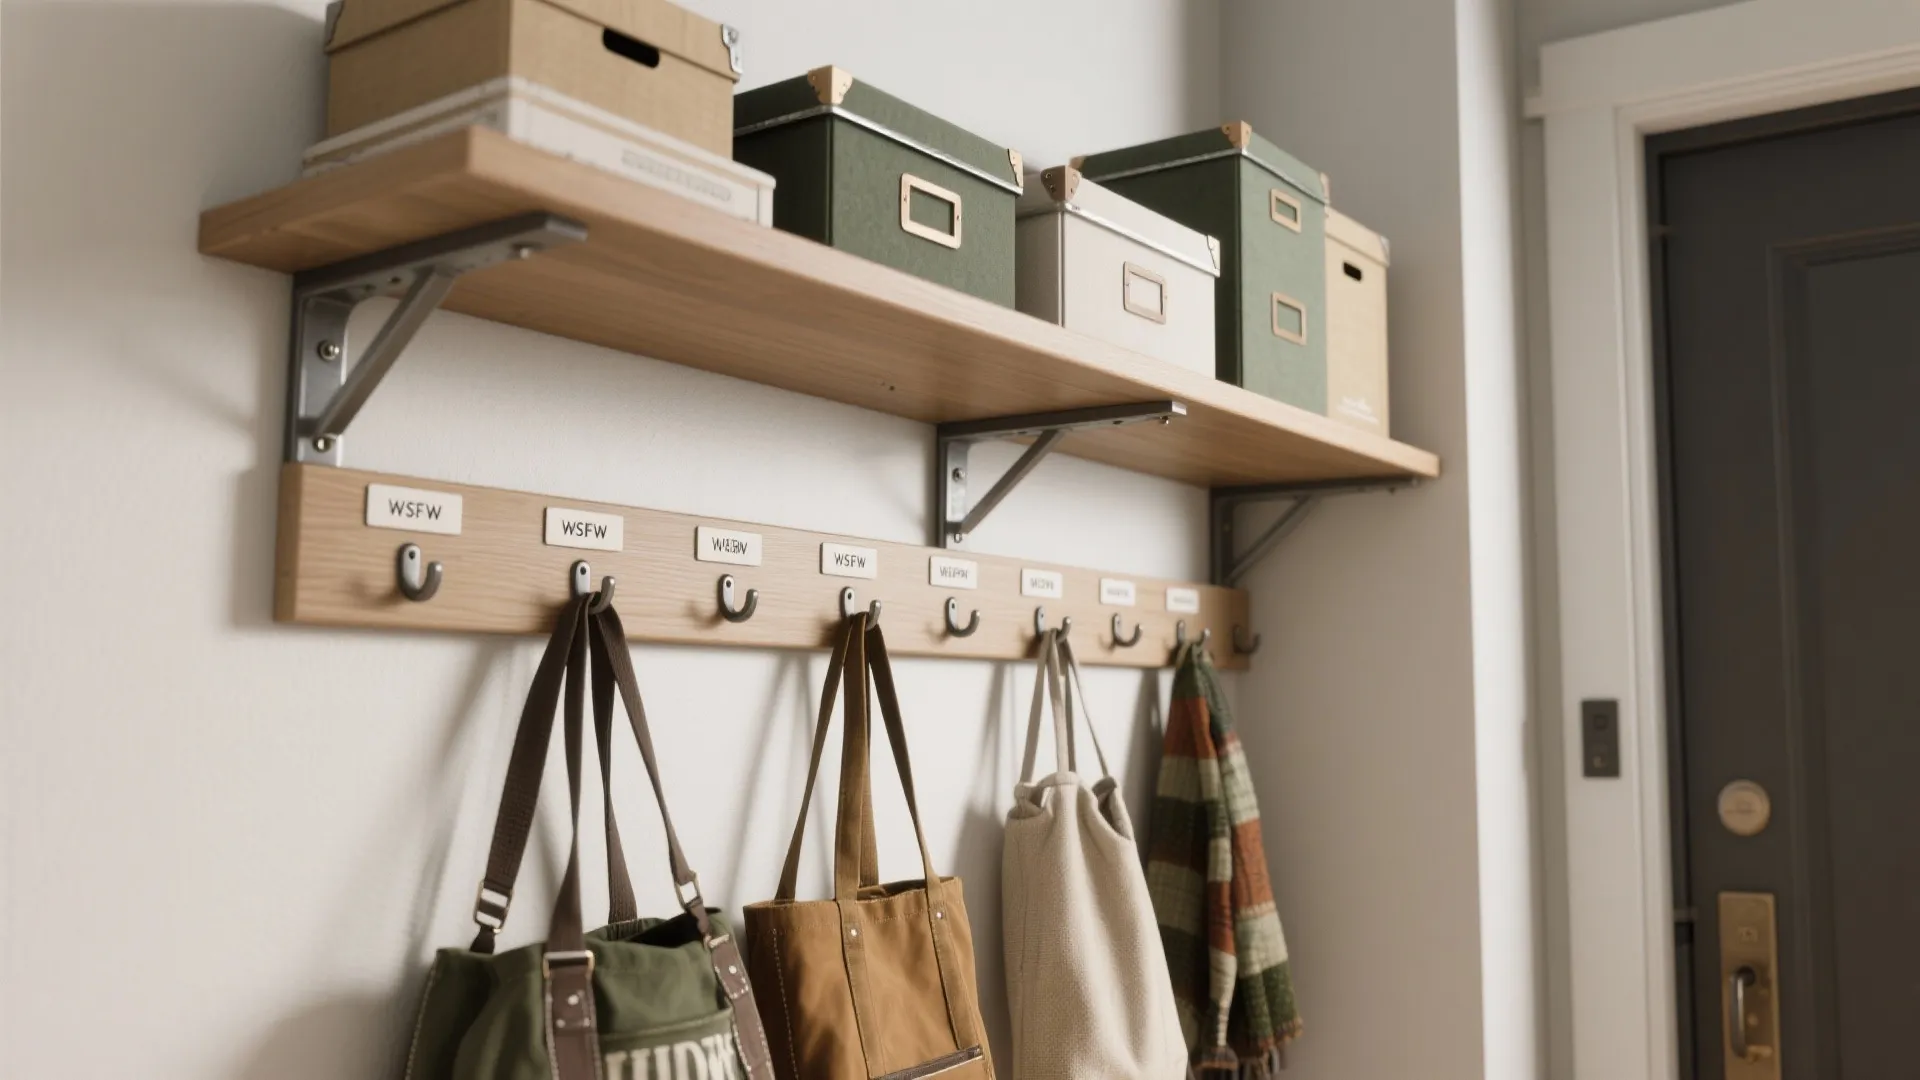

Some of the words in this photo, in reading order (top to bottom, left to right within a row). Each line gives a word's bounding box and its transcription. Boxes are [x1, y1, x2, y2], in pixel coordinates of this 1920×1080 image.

[388, 498, 442, 520] WSFW
[562, 519, 607, 539] WSFW
[834, 551, 866, 568] WSFW
